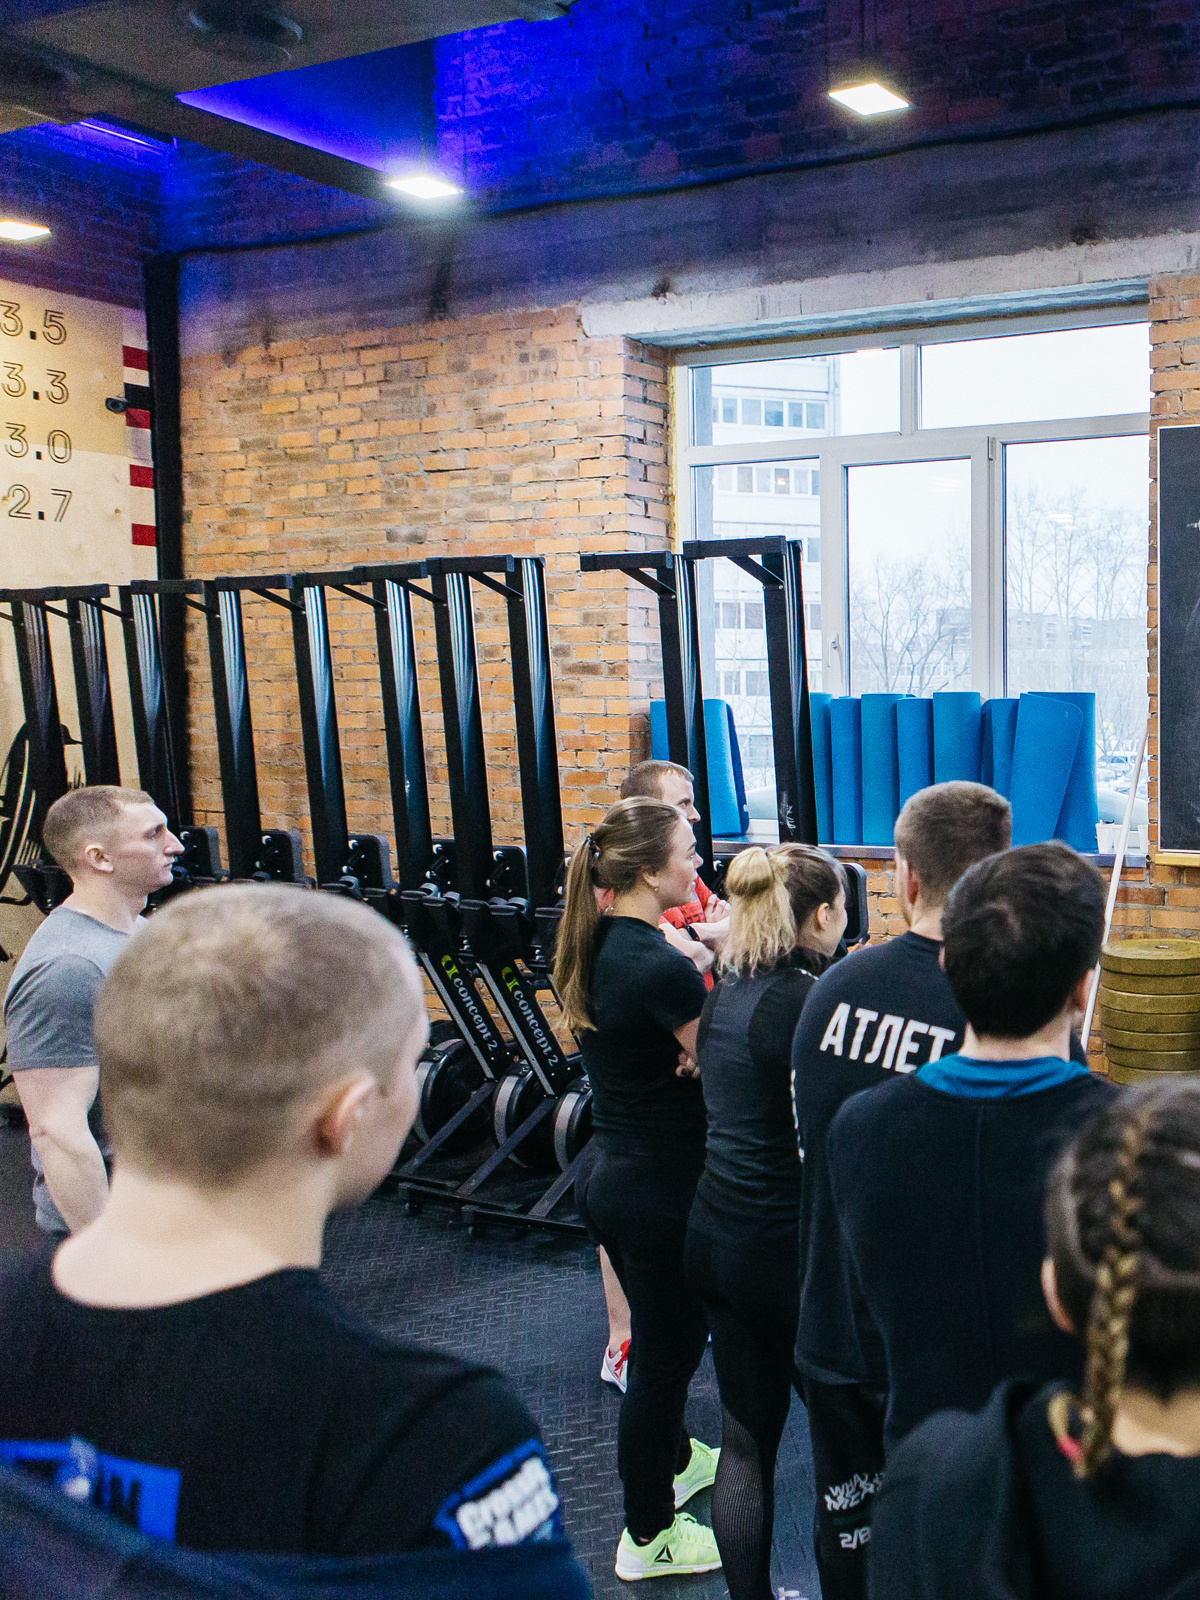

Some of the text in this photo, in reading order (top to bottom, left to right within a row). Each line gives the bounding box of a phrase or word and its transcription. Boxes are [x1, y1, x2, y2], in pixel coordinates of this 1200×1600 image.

[0, 301, 67, 345] 3.5
[2, 361, 69, 404] 3.3
[5, 422, 72, 463] 3.0
[8, 484, 73, 522] 2.7
[819, 1002, 957, 1074] АТЛЕТ
